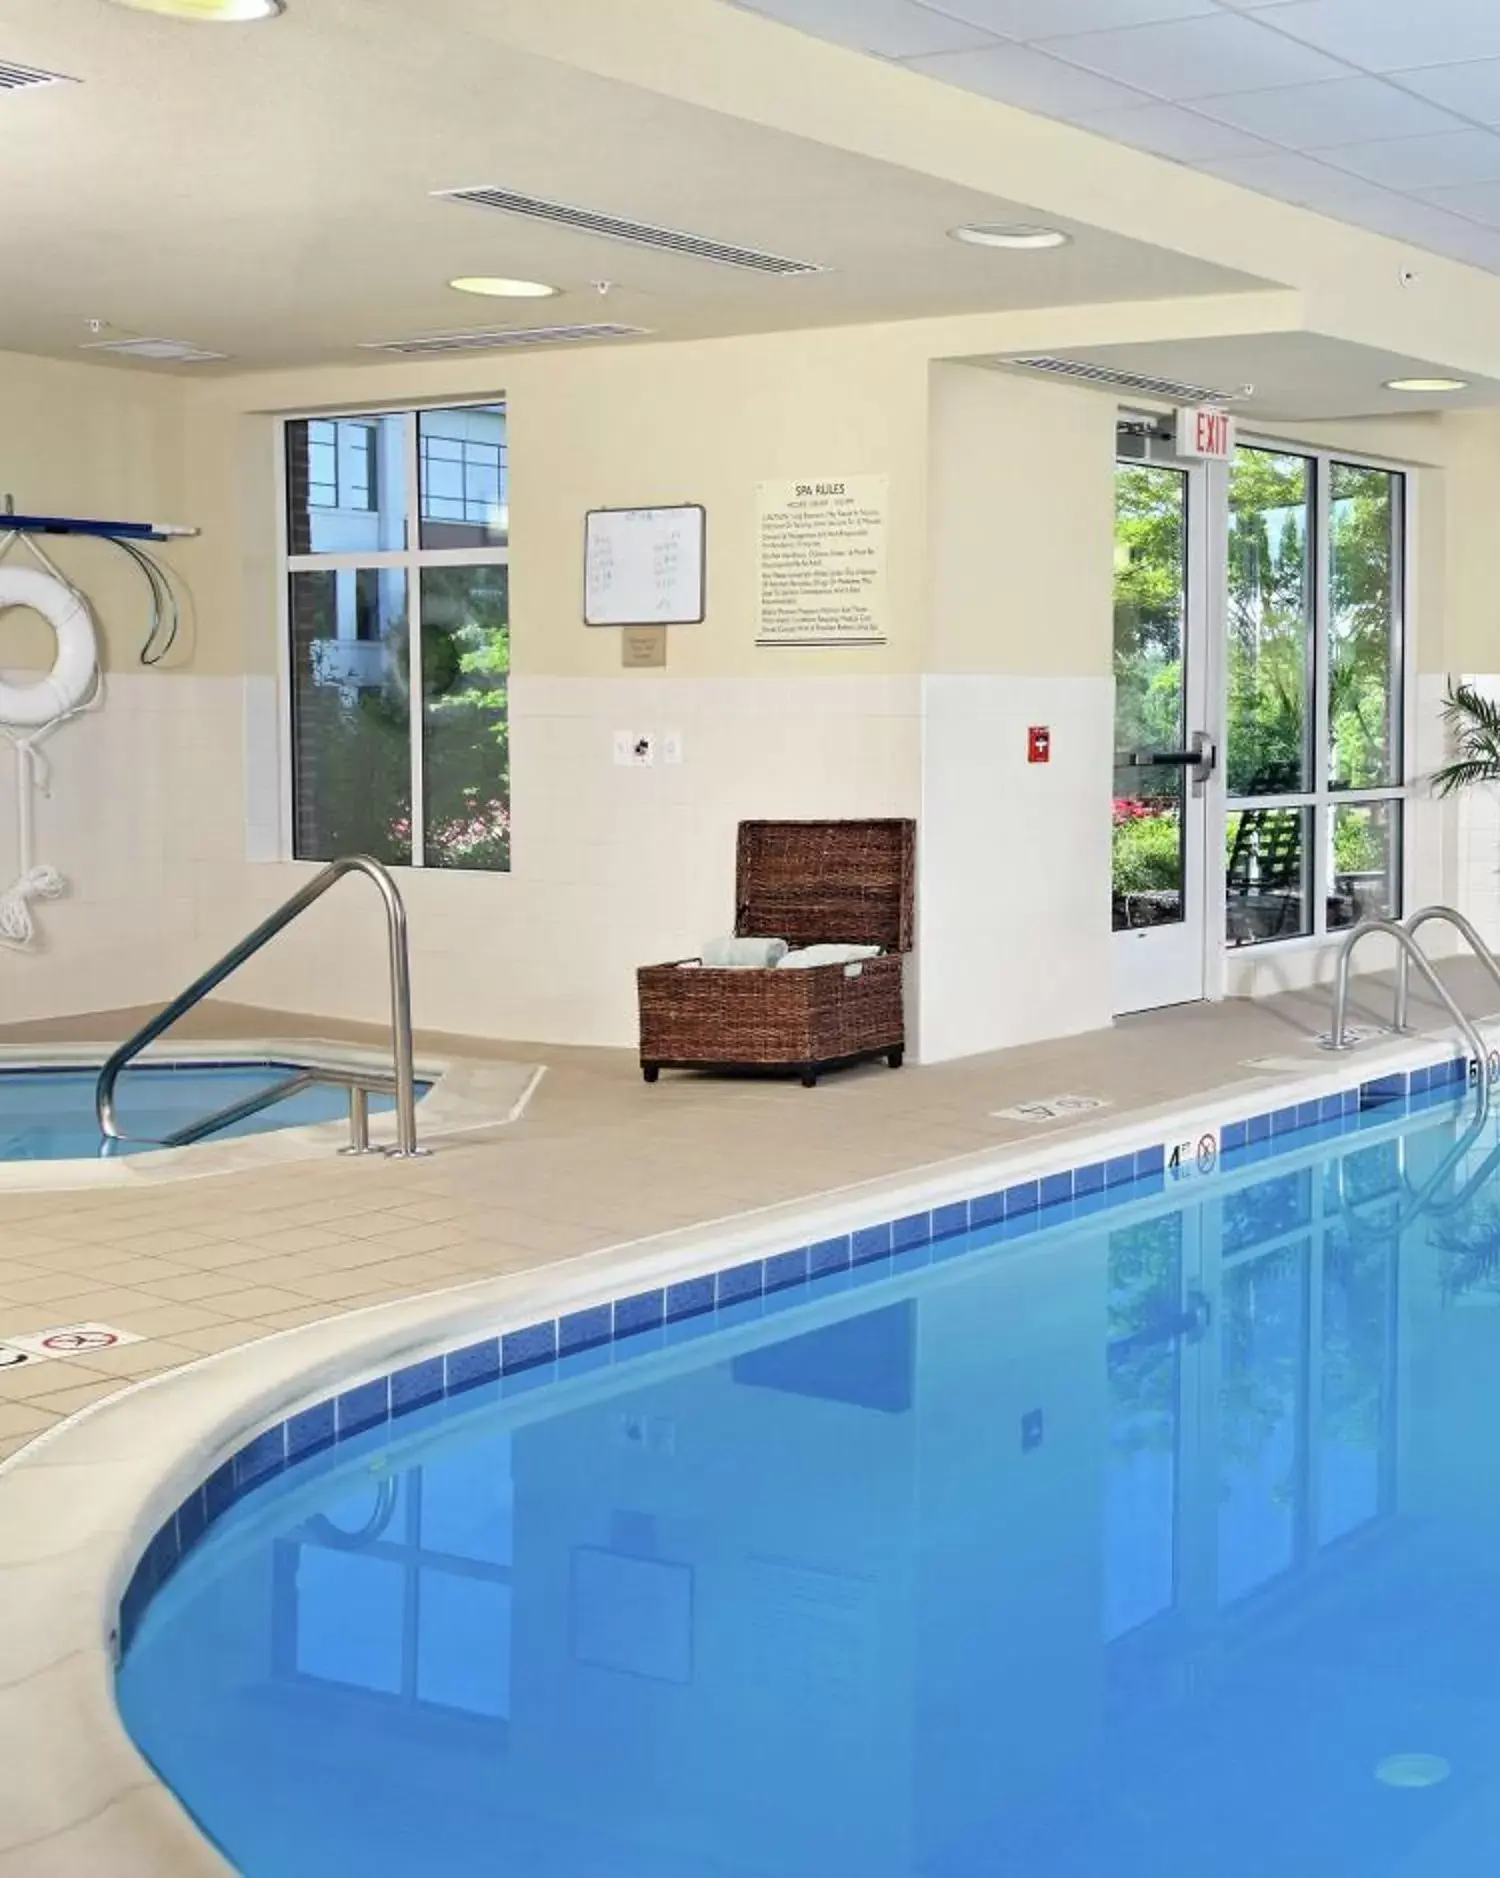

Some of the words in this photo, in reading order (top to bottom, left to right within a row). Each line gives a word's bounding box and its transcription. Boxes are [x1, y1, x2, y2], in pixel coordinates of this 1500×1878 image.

[1196, 412, 1229, 455] EXIT
[795, 484, 813, 497] SPA
[815, 482, 845, 496] RULES
[1166, 1144, 1180, 1168] 4
